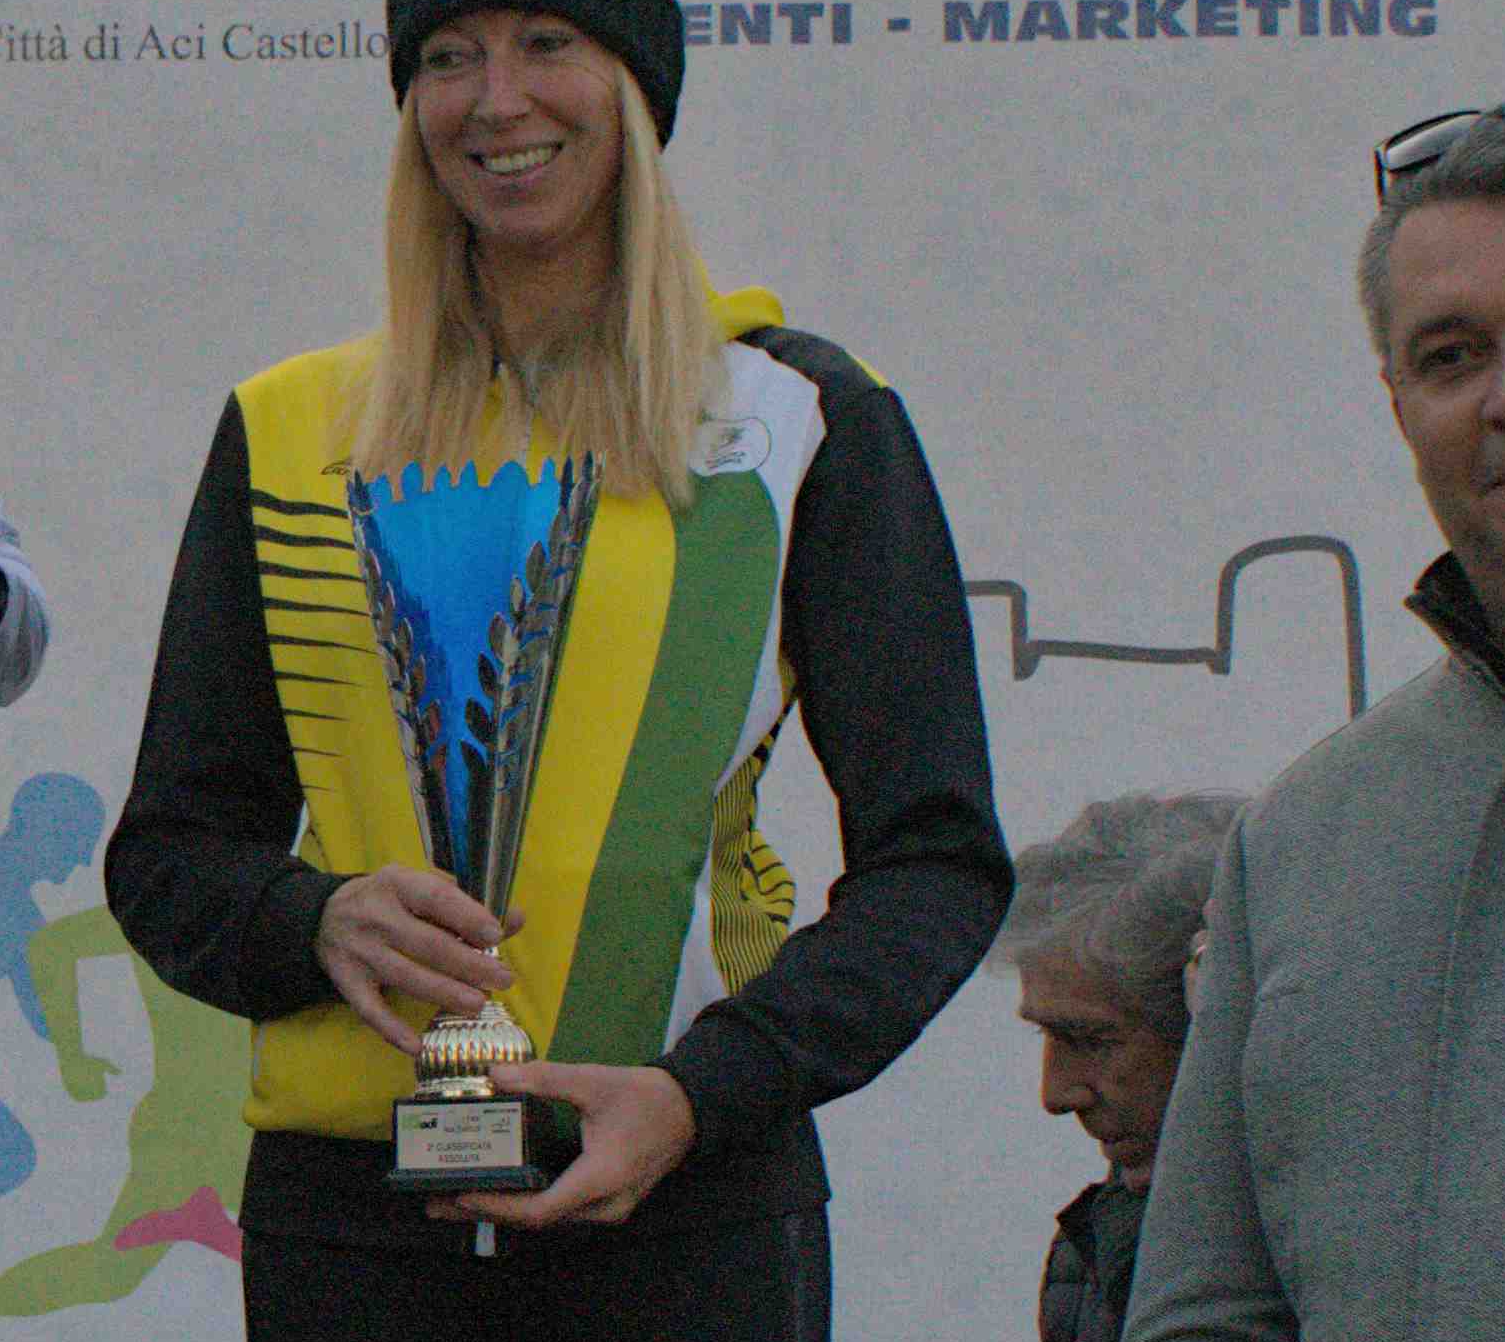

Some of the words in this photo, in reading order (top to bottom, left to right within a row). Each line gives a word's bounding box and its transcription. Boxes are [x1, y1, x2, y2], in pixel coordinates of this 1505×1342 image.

[83, 25, 129, 61] di
[141, 24, 208, 61] Aci
[222, 21, 387, 61] Castello
[684, 2, 851, 45] ENTI
